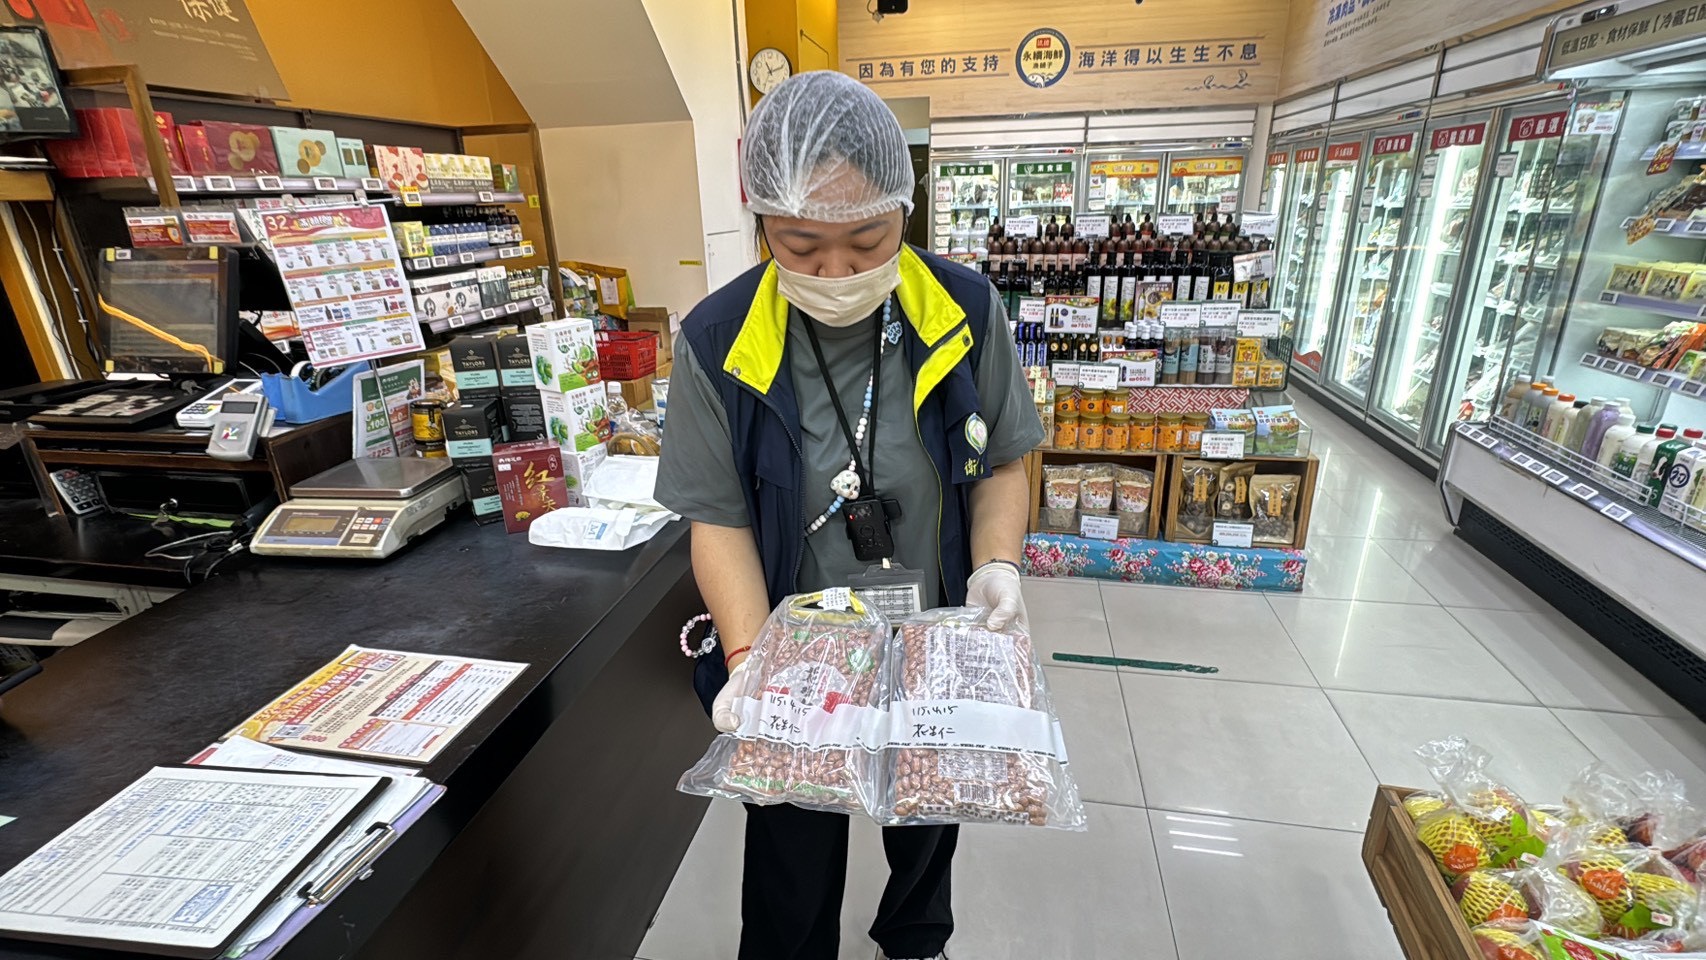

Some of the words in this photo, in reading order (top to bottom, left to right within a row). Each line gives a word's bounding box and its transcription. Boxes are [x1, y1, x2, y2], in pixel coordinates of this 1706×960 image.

[1022, 49, 1064, 61] 永續海鮮
[1078, 42, 1258, 69] 海洋得以生生不息
[858, 54, 999, 79] 因為有您的支持
[1534, 115, 1566, 135] 嚴選
[1037, 163, 1063, 173] 素食區
[265, 215, 289, 231] 32
[964, 458, 984, 476] 衛
[769, 715, 801, 734] 花生仁
[912, 723, 956, 739] 花生仁
